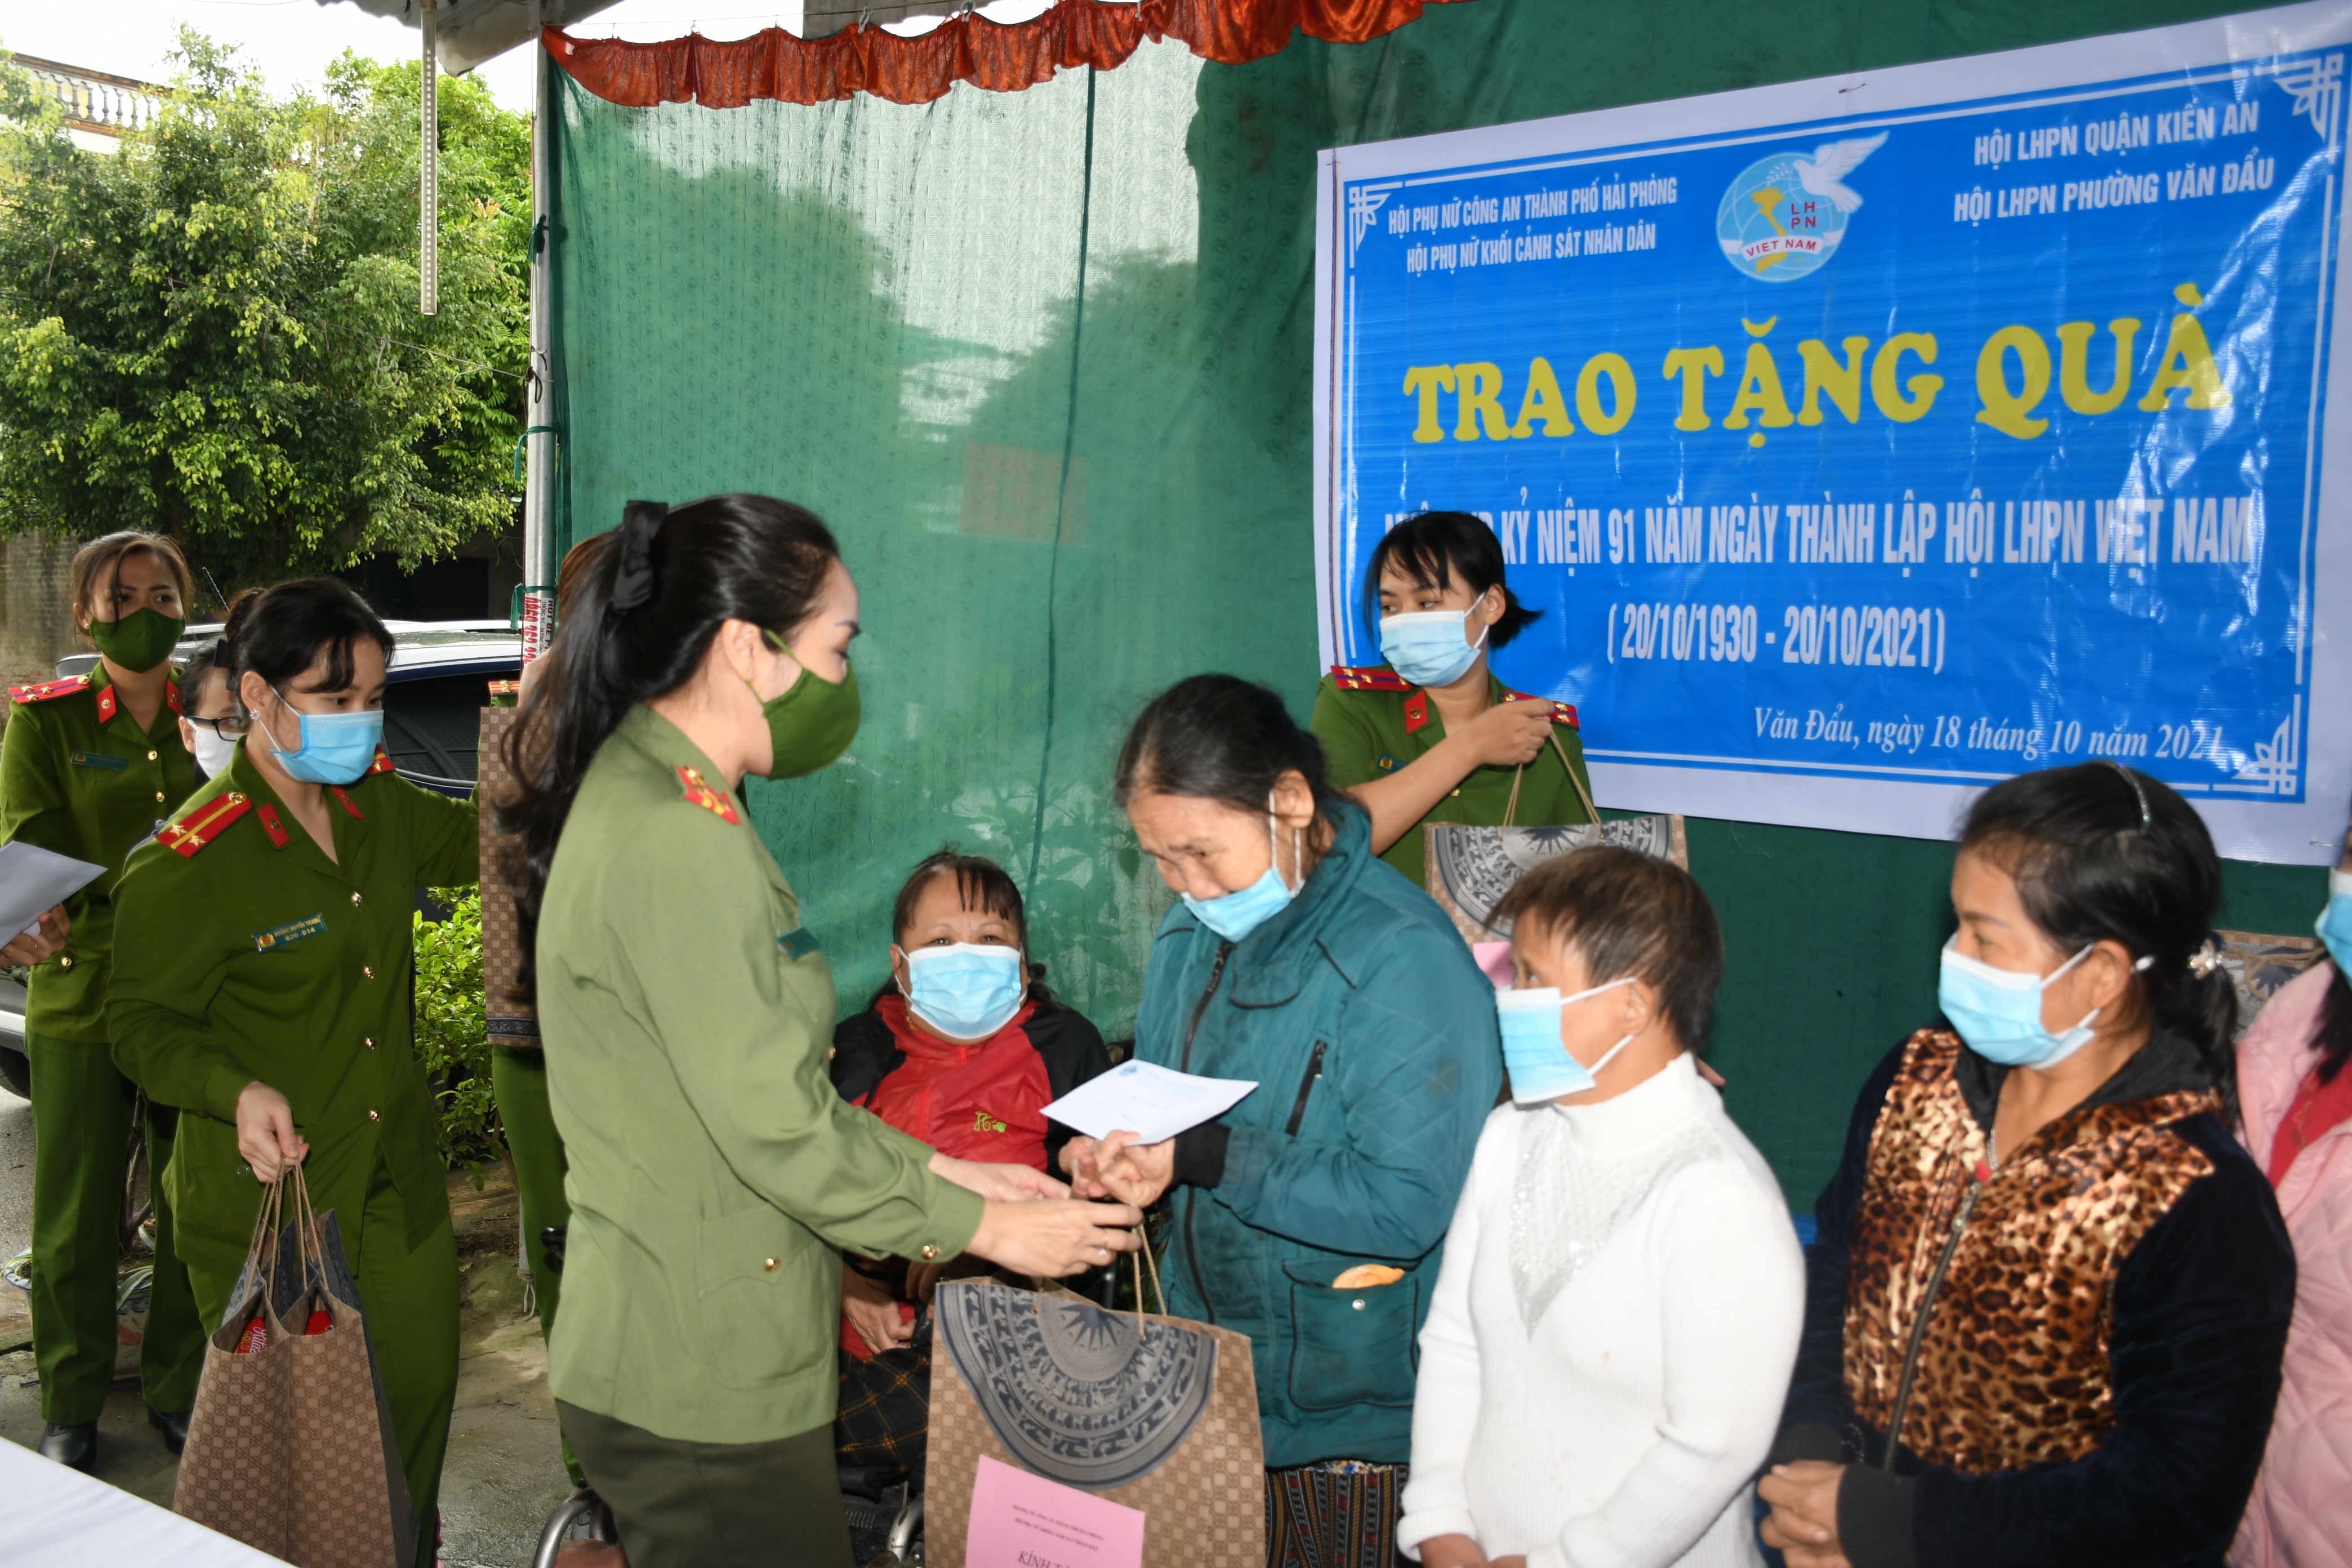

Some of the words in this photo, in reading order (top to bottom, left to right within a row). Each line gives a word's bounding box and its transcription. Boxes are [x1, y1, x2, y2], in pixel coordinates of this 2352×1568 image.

[1975, 128, 2011, 170] HỘI
[2018, 125, 2077, 161] LHPN
[2084, 112, 2148, 156] QUẬN
[2221, 101, 2259, 136] AN
[1389, 204, 1410, 239] HỘI
[1413, 206, 1438, 235] PHỤ
[1442, 197, 1462, 229] NỮ
[1463, 195, 1499, 226] CÔNG
[1502, 196, 1521, 222] AN
[1524, 187, 1568, 220] THÀNH
[1571, 177, 1600, 215] PHỐ
[1602, 173, 1625, 211] HẢI
[1629, 173, 1677, 208] PHÒNG
[1954, 186, 1992, 227] HỘI
[1997, 185, 2056, 218] LHPN
[2063, 169, 2159, 212] PHƯỜNG
[2167, 162, 2215, 201] VĂN
[2221, 147, 2274, 194] ĐẨU
[1407, 242, 1427, 278] HỘI
[1431, 244, 1456, 275] PHỤ
[1460, 235, 1480, 268] NỮ
[1481, 229, 1512, 265] KHỐI
[1515, 225, 1552, 262] CẢNH
[1556, 227, 1581, 259] SÁT
[1584, 223, 1623, 256] NHÂN
[1627, 219, 1656, 251] DÂN
[1746, 240, 1779, 256] VIET
[1785, 239, 1816, 251] NAM
[1404, 353, 1637, 443] TRAO
[1662, 316, 1944, 448] TẶNG
[1975, 283, 2233, 440] QUÀ
[1501, 486, 1530, 564] KỶ
[1537, 497, 1600, 577] NIỆM
[1607, 508, 1634, 564] 91
[1645, 495, 1701, 563] NĂM
[1709, 493, 1779, 564] NGÀY
[1786, 491, 1875, 563] THÀNH
[1883, 489, 1936, 577] LẬP
[1945, 488, 1995, 578] HỘI
[2004, 500, 2084, 563] LHPN
[2095, 483, 2164, 578] VIỆT
[2172, 497, 2253, 563] NAM
[1607, 603, 1757, 664] (20/10/1930
[1765, 632, 1775, 644] -
[1783, 605, 1944, 675] 20/10/2021)
[1754, 707, 1798, 740] Văn
[1803, 703, 1859, 750] Đẩu,
[1867, 714, 1924, 755] ngày
[1930, 715, 1961, 749] 18
[1968, 717, 2041, 760] tháng
[2049, 720, 2081, 754] 10
[2087, 723, 2148, 757] năm
[2154, 724, 2223, 760] 2021
[240, 1331, 252, 1350] GOLD
[1017, 1550, 1051, 1568] KÍNH
